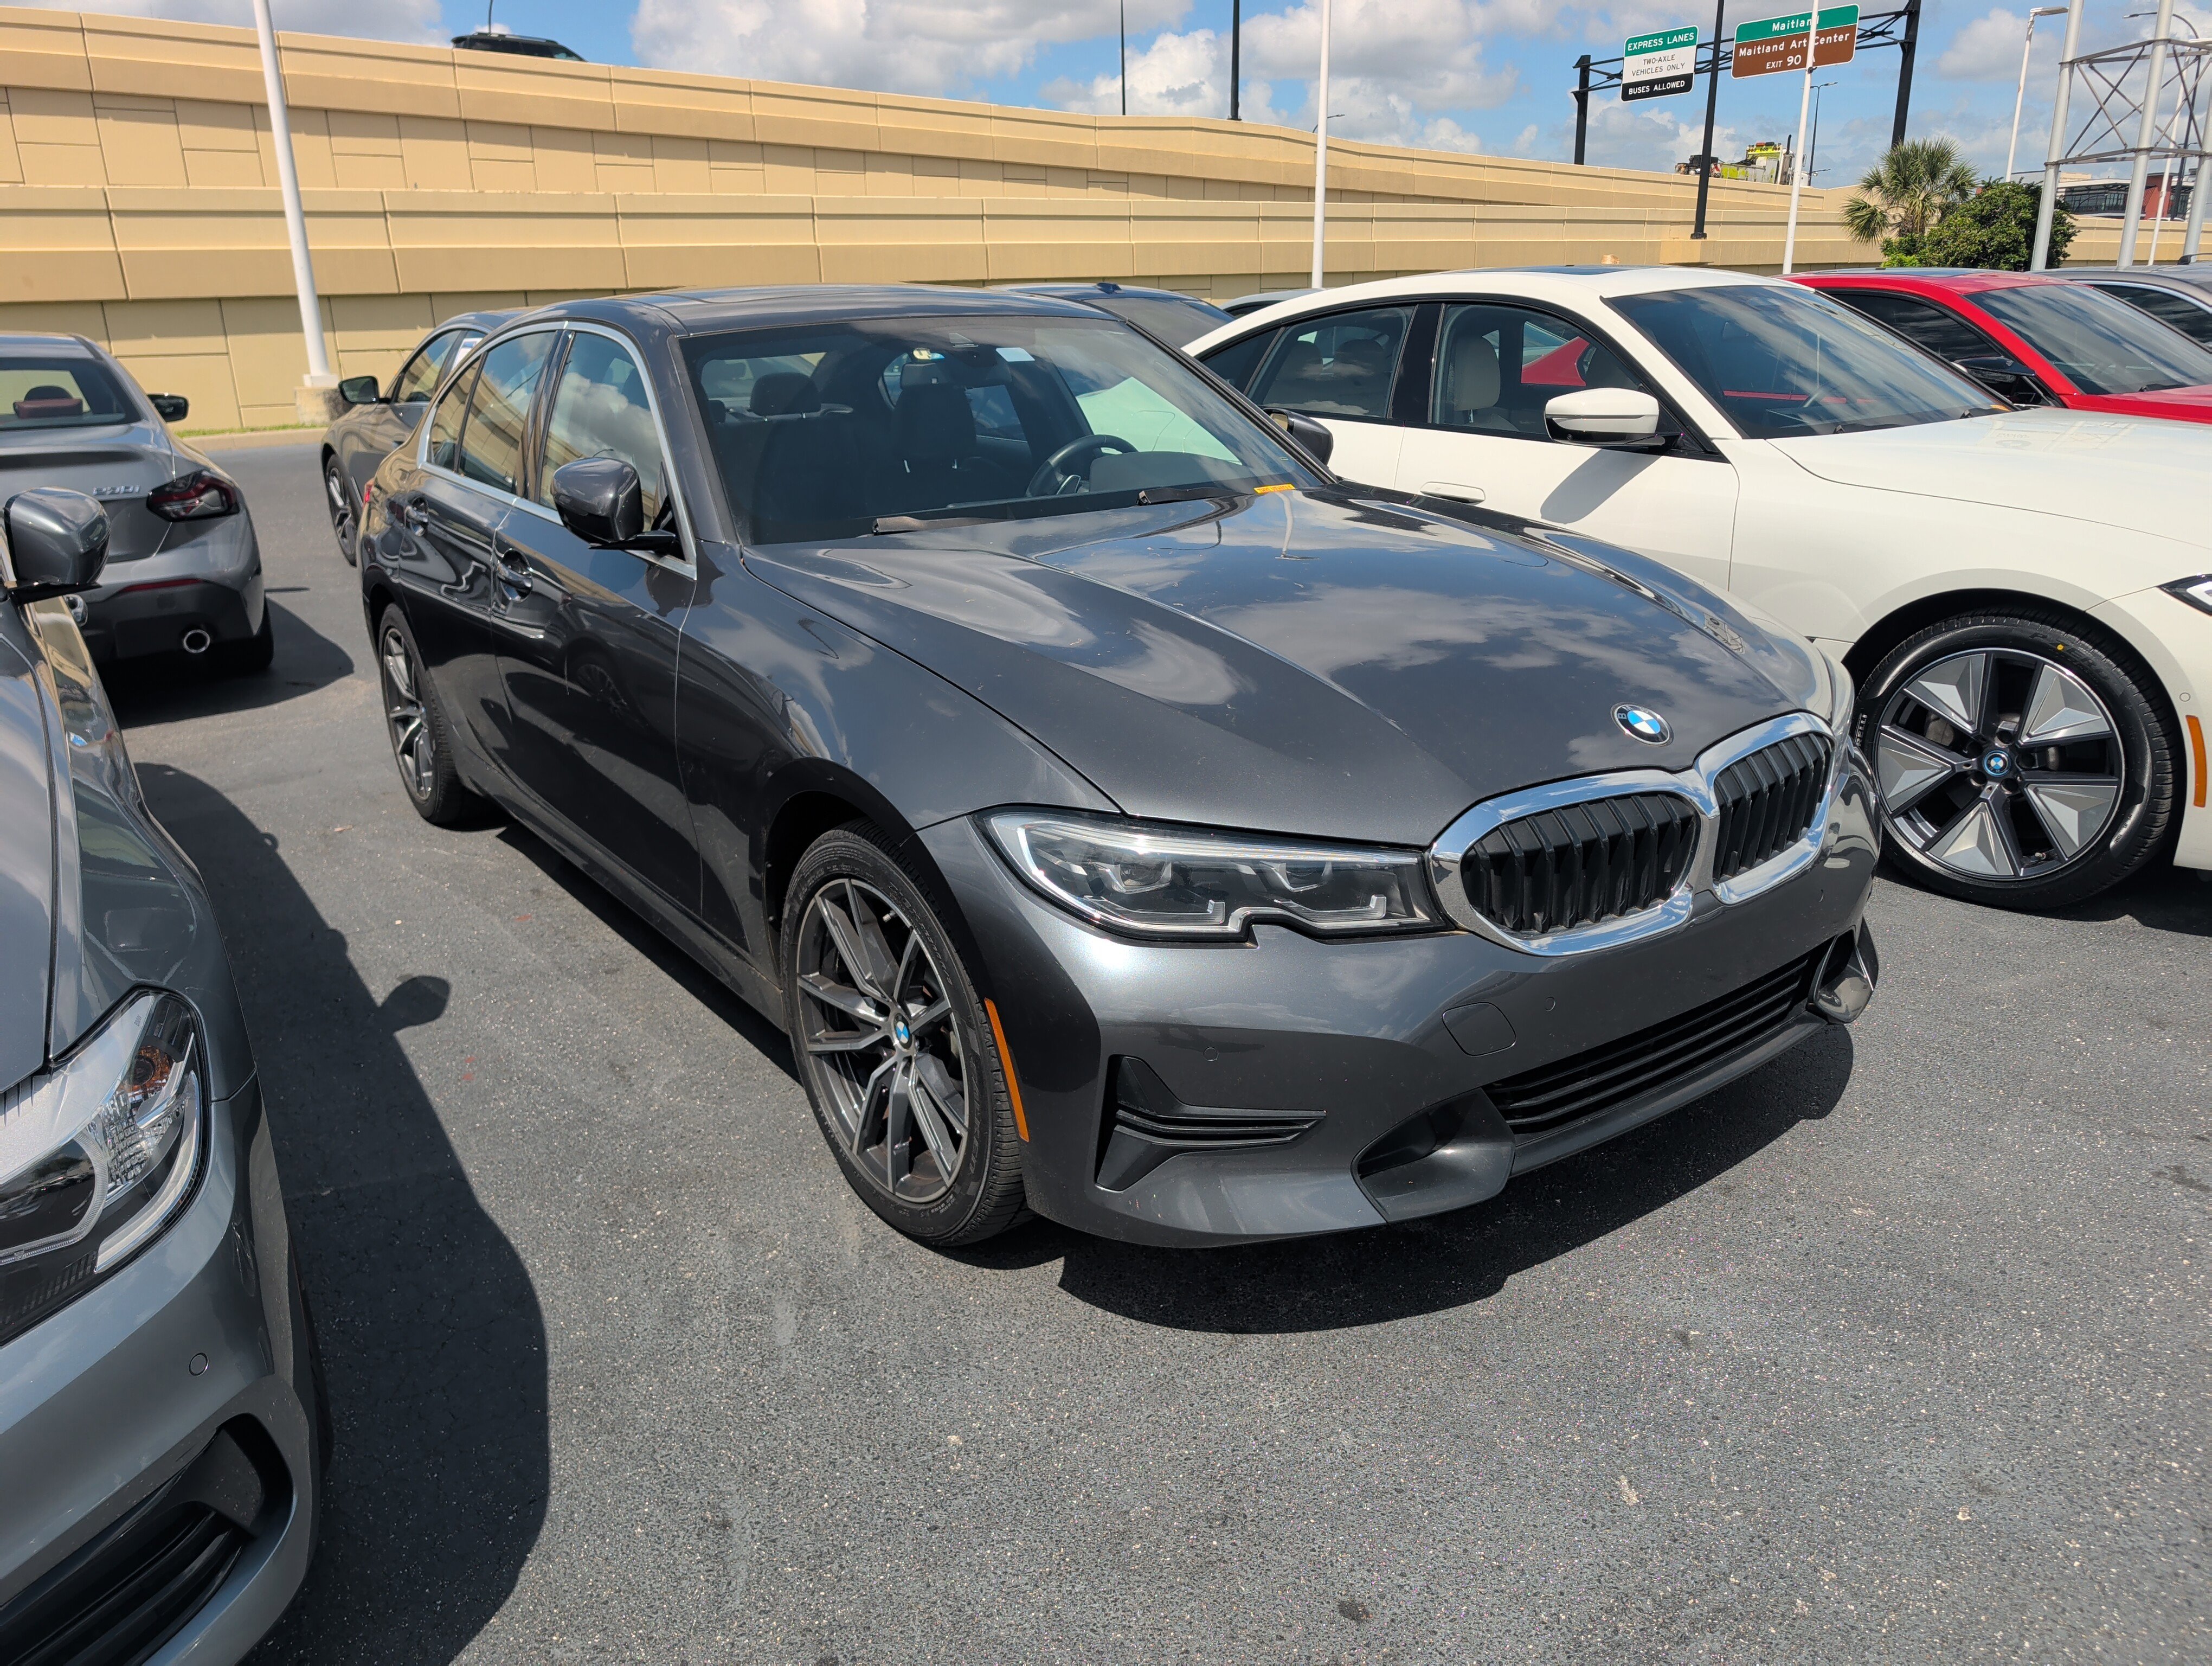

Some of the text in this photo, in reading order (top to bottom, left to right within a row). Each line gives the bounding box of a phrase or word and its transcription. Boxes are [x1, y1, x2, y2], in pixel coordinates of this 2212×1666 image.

[1628, 33, 1694, 51] EXPRESS LANES
[1739, 41, 1784, 56] Maitland
[1790, 39, 1806, 49] Art
[1643, 54, 1675, 65] TWO-AXLE
[1766, 60, 1783, 69] EXIT
[1787, 55, 1802, 66] 90
[1632, 62, 1685, 76] VEHICLES ONLY
[1629, 80, 1685, 95] BUSES ALLOWED
